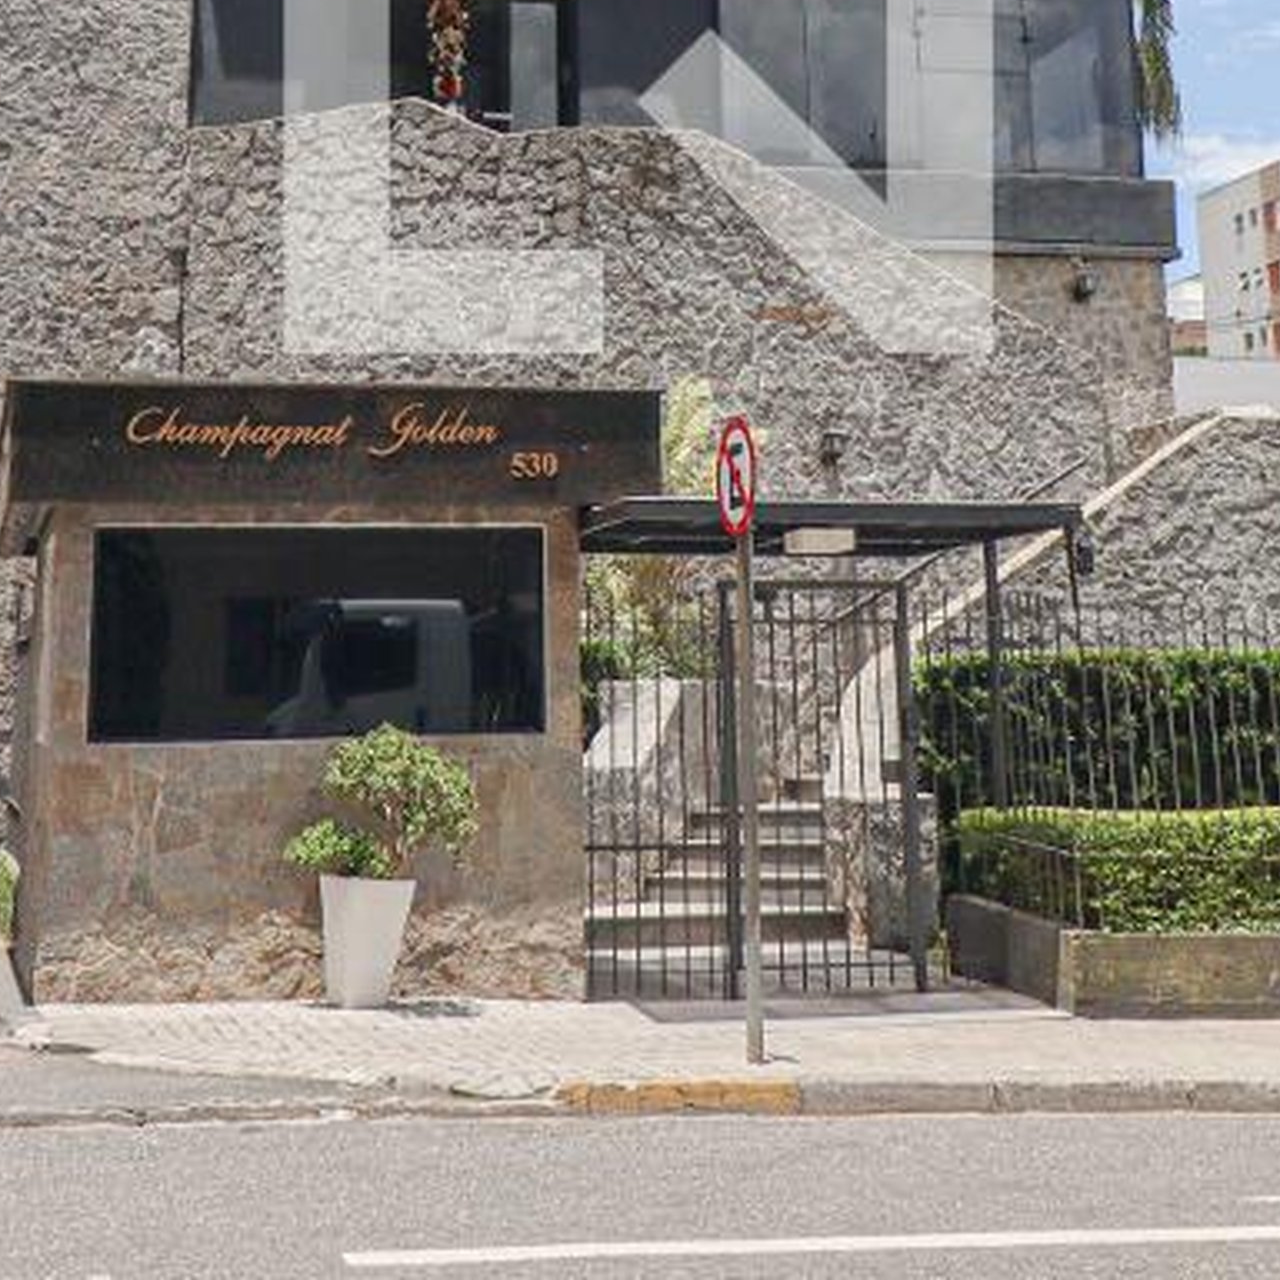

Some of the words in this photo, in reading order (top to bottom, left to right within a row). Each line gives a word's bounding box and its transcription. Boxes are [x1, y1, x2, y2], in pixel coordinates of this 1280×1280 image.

[126, 404, 353, 457] Champagnat
[368, 402, 499, 457] Golden
[509, 452, 558, 478] 530
